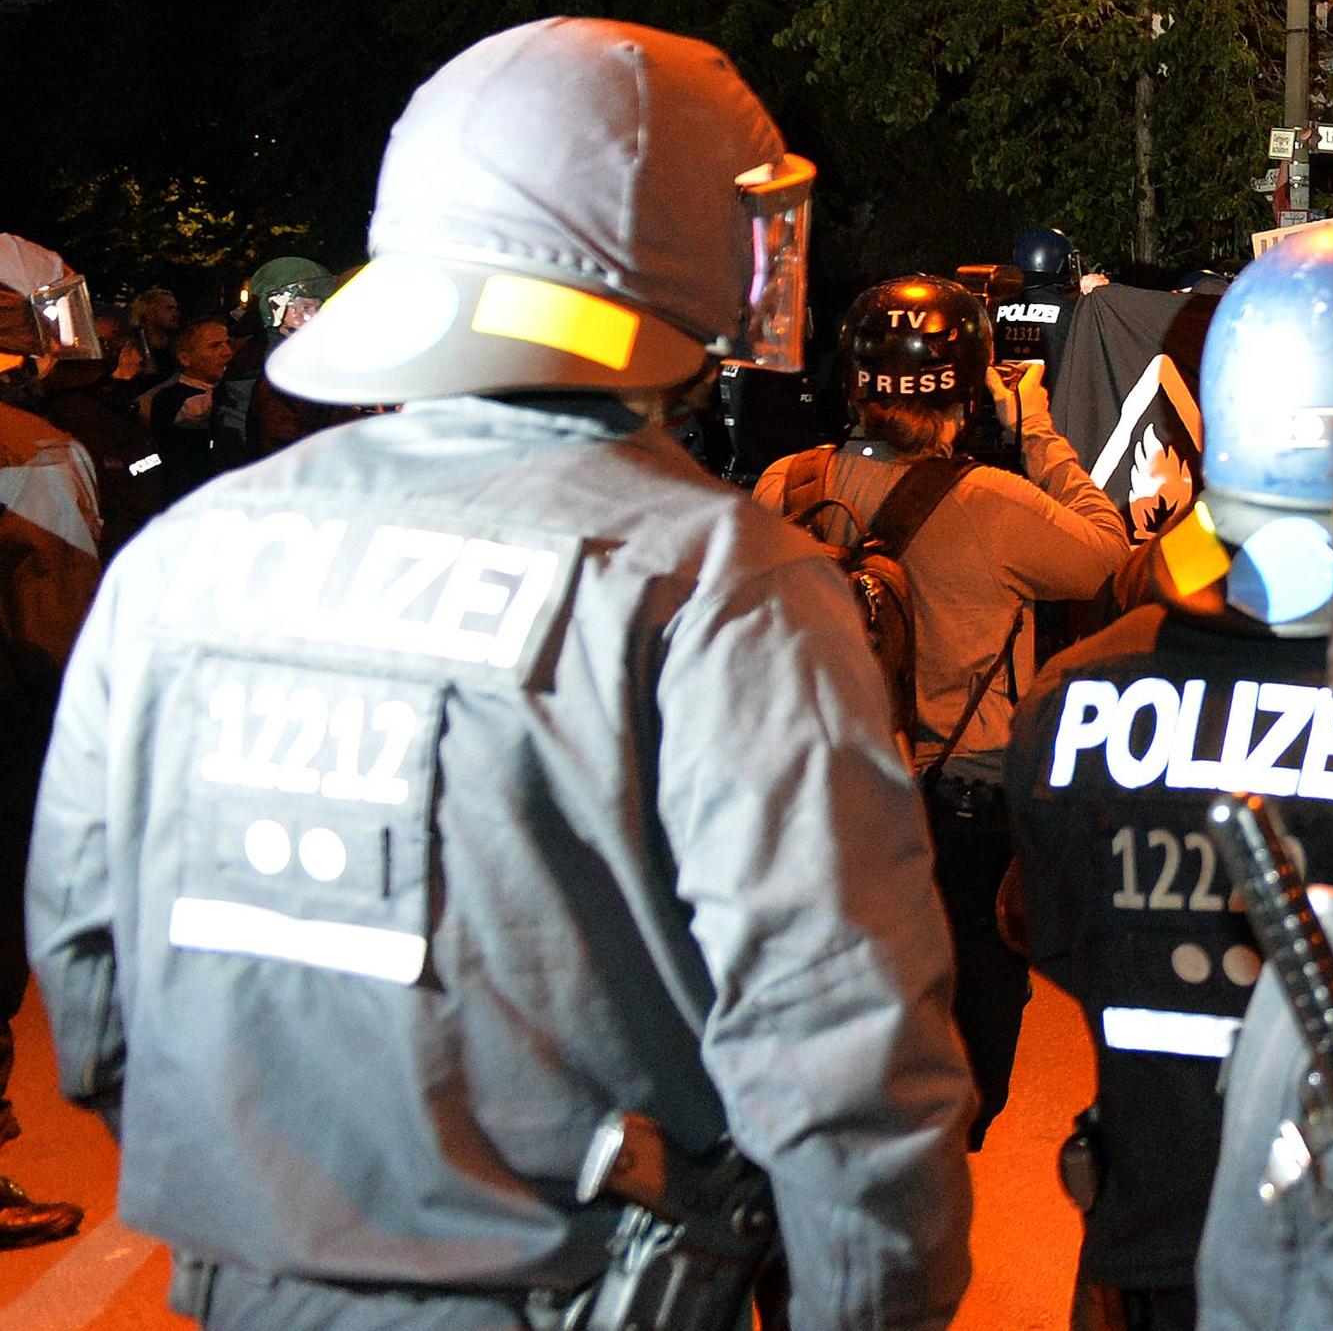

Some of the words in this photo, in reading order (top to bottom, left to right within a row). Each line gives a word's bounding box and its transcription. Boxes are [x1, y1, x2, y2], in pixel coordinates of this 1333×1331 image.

[887, 309, 928, 330] TV
[997, 303, 1060, 324] POLIZEI
[857, 370, 956, 394] PRESS
[159, 509, 558, 668] POLIZEI
